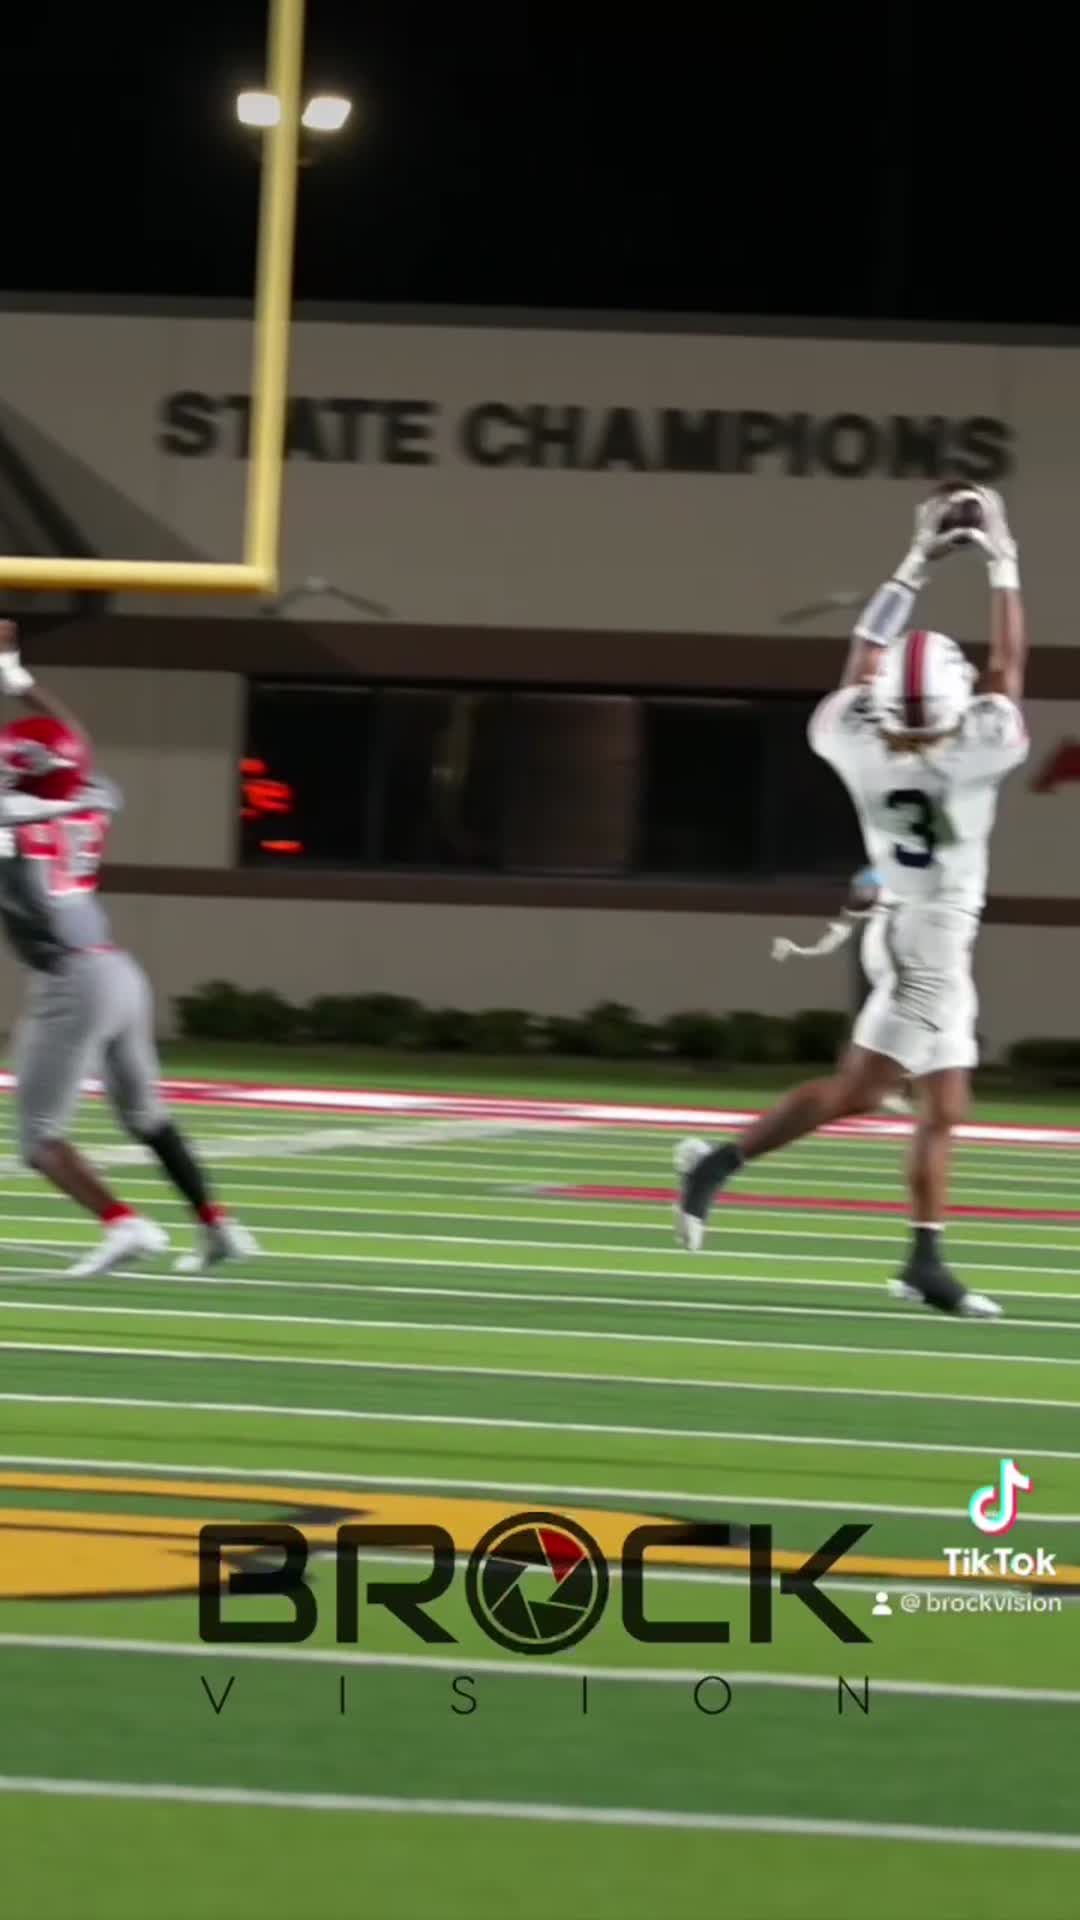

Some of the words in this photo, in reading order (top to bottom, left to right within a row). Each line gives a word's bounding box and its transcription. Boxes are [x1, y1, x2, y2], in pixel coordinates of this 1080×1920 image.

[159, 391, 435, 466] STATE
[462, 402, 1013, 481] CHAMPIONS
[886, 788, 939, 869] 3
